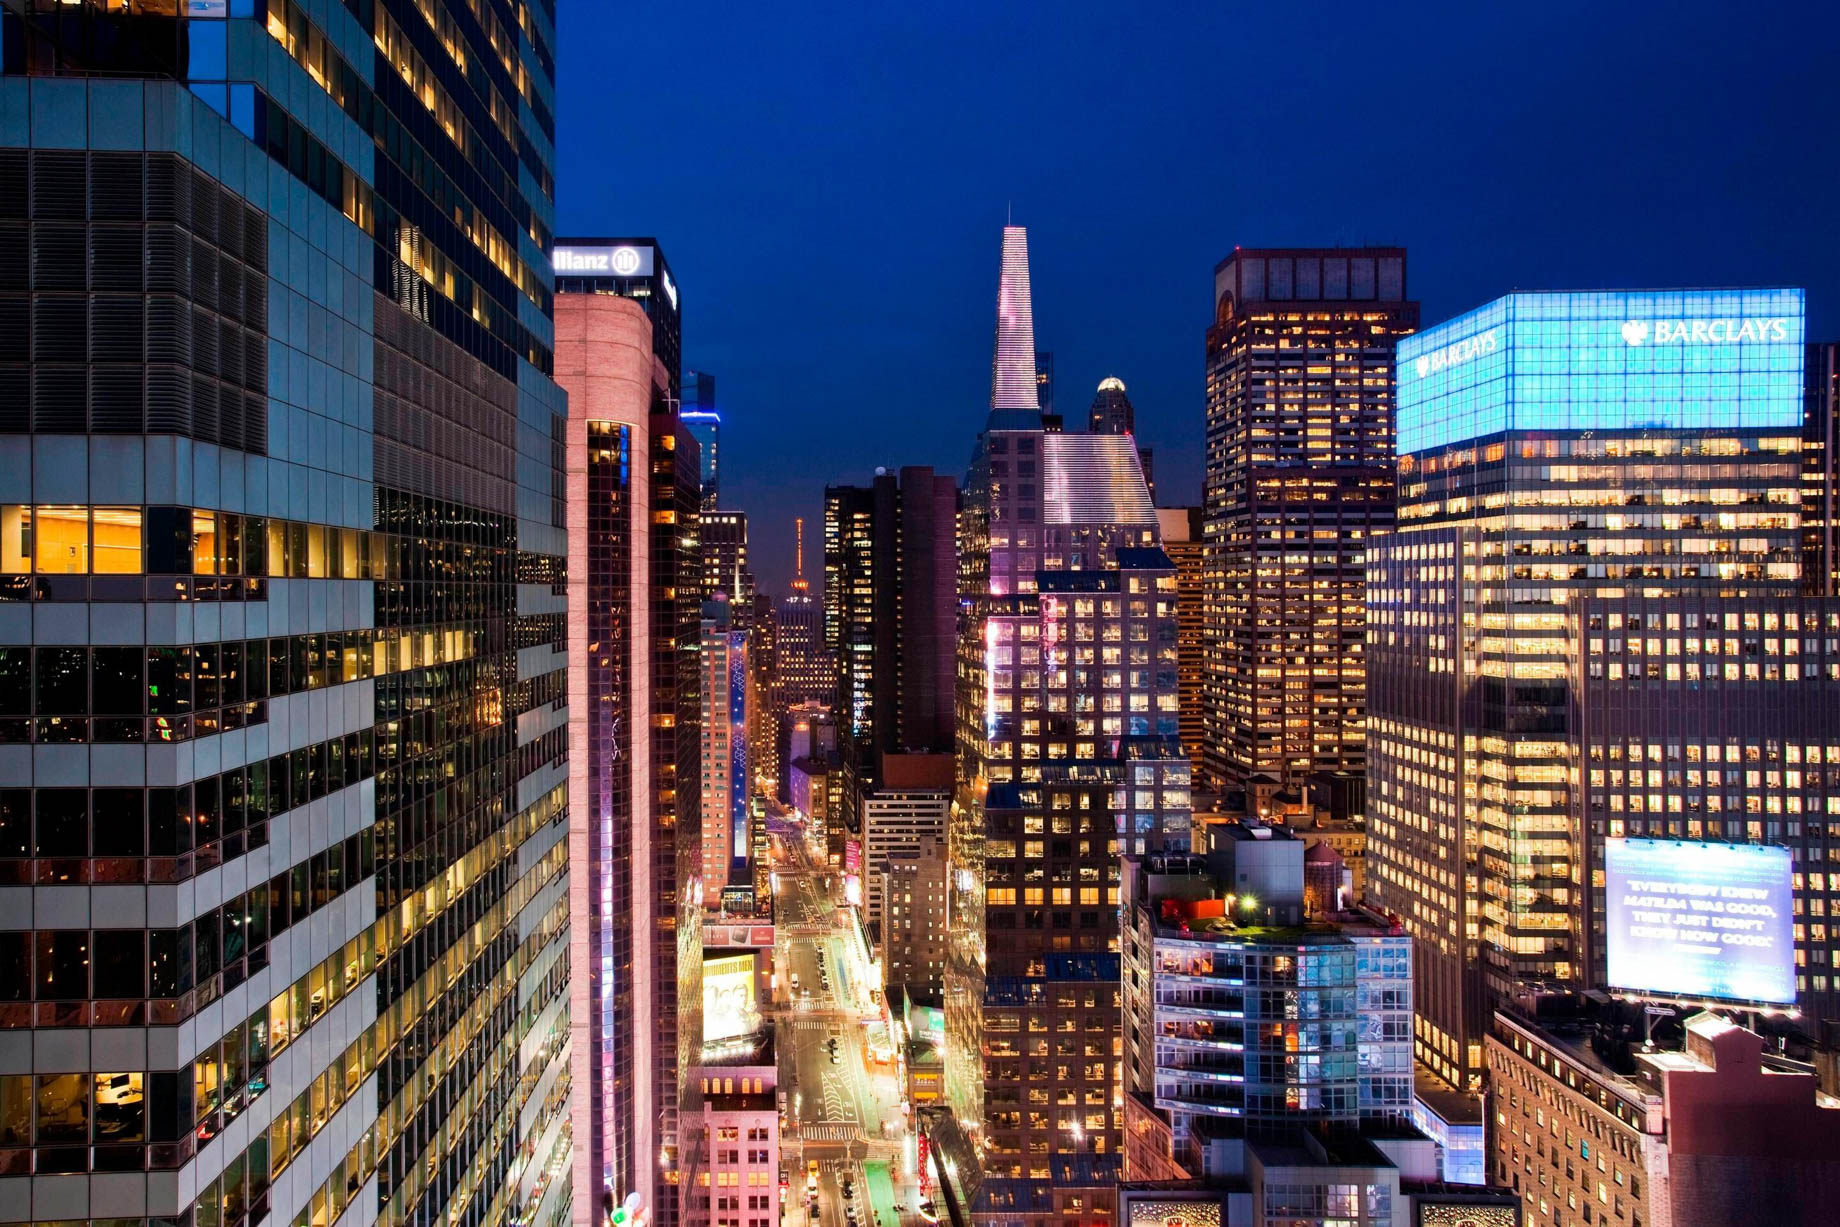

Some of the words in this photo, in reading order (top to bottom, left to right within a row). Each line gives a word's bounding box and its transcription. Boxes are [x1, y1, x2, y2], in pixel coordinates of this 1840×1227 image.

[553, 250, 608, 270] llianz
[1654, 318, 1788, 343] BARCLAYS
[1431, 329, 1497, 371] BARCLAYS
[1624, 895, 1687, 910] MATILDA
[1689, 899, 1725, 913] WAS
[1726, 902, 1777, 918] GOOD,
[1632, 911, 1671, 924] THEY
[1673, 913, 1709, 927] JUST
[1680, 929, 1719, 943] HOW
